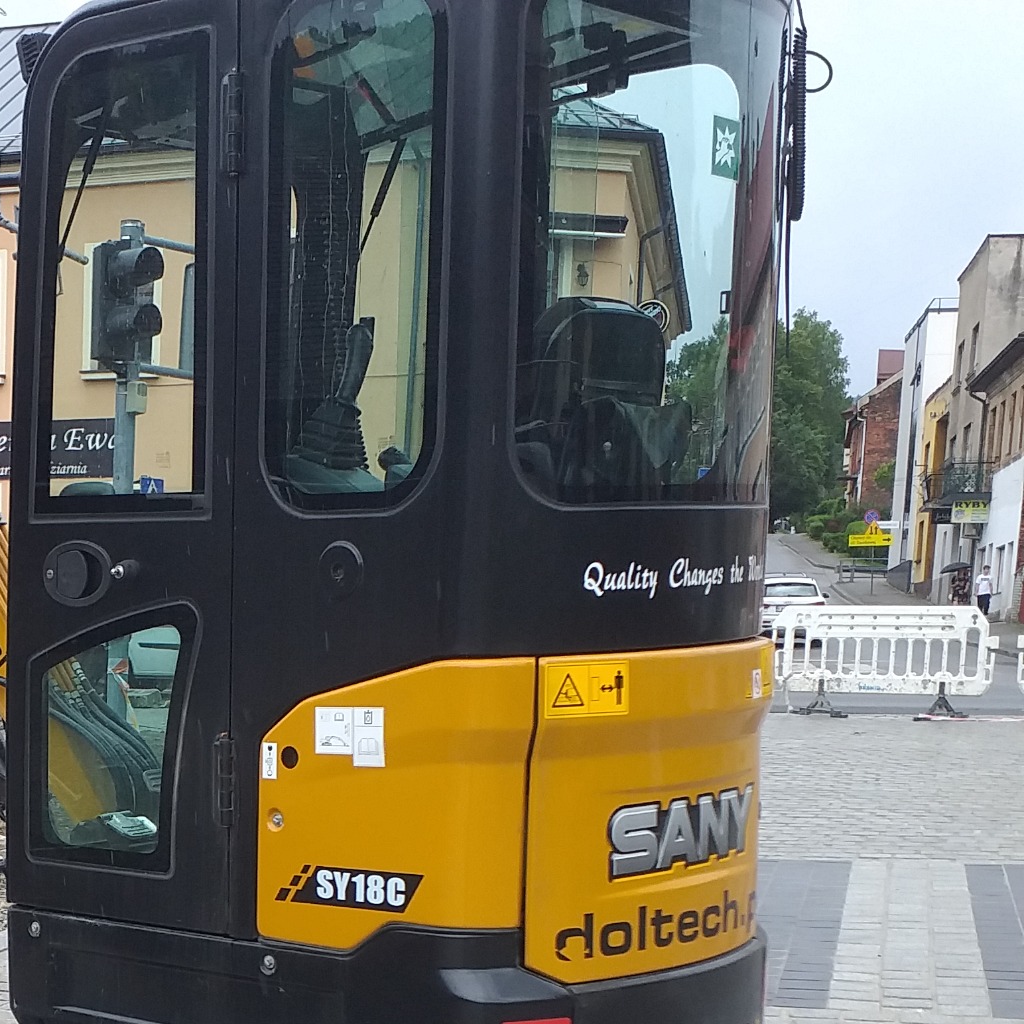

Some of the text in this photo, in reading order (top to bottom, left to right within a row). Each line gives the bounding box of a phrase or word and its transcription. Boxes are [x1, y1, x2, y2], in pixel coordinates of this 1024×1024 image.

[954, 501, 989, 509] RYBY
[583, 561, 659, 599] Quality
[669, 557, 724, 595] Changes
[730, 555, 744, 584] the
[608, 782, 755, 880] SANY
[316, 869, 406, 907] SY18C
[555, 890, 756, 961] doltech.p
